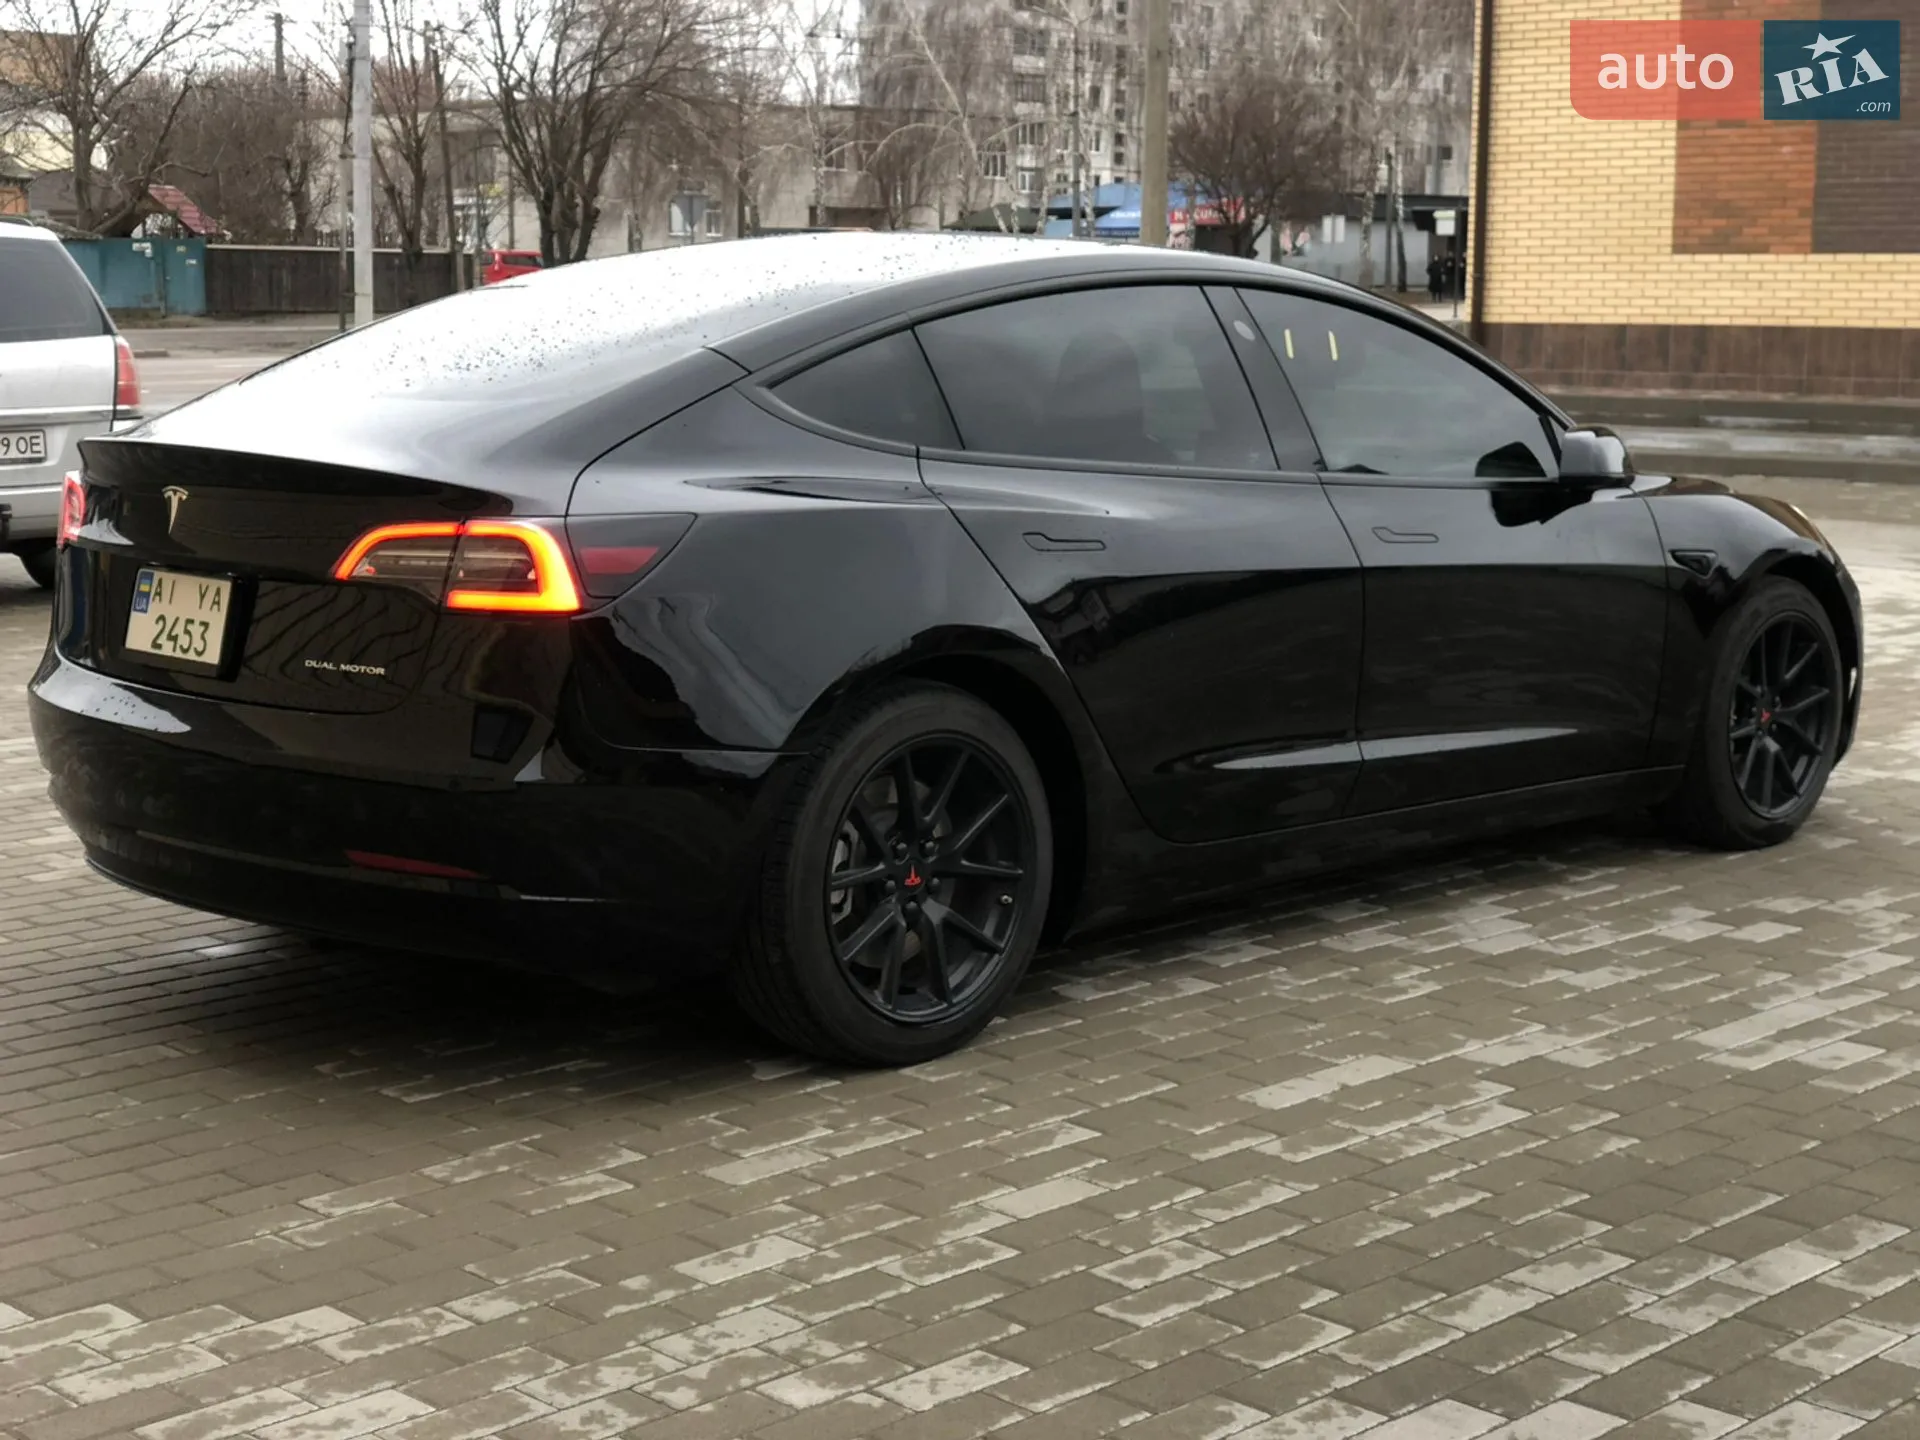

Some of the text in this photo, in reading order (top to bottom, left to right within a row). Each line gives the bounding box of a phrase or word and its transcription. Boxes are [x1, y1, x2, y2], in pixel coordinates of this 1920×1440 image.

[15, 436, 42, 455] OE
[135, 597, 147, 610] UA
[151, 577, 222, 612] AI YA
[150, 613, 210, 657] 2453
[304, 659, 386, 676] DUAL MOTOR
